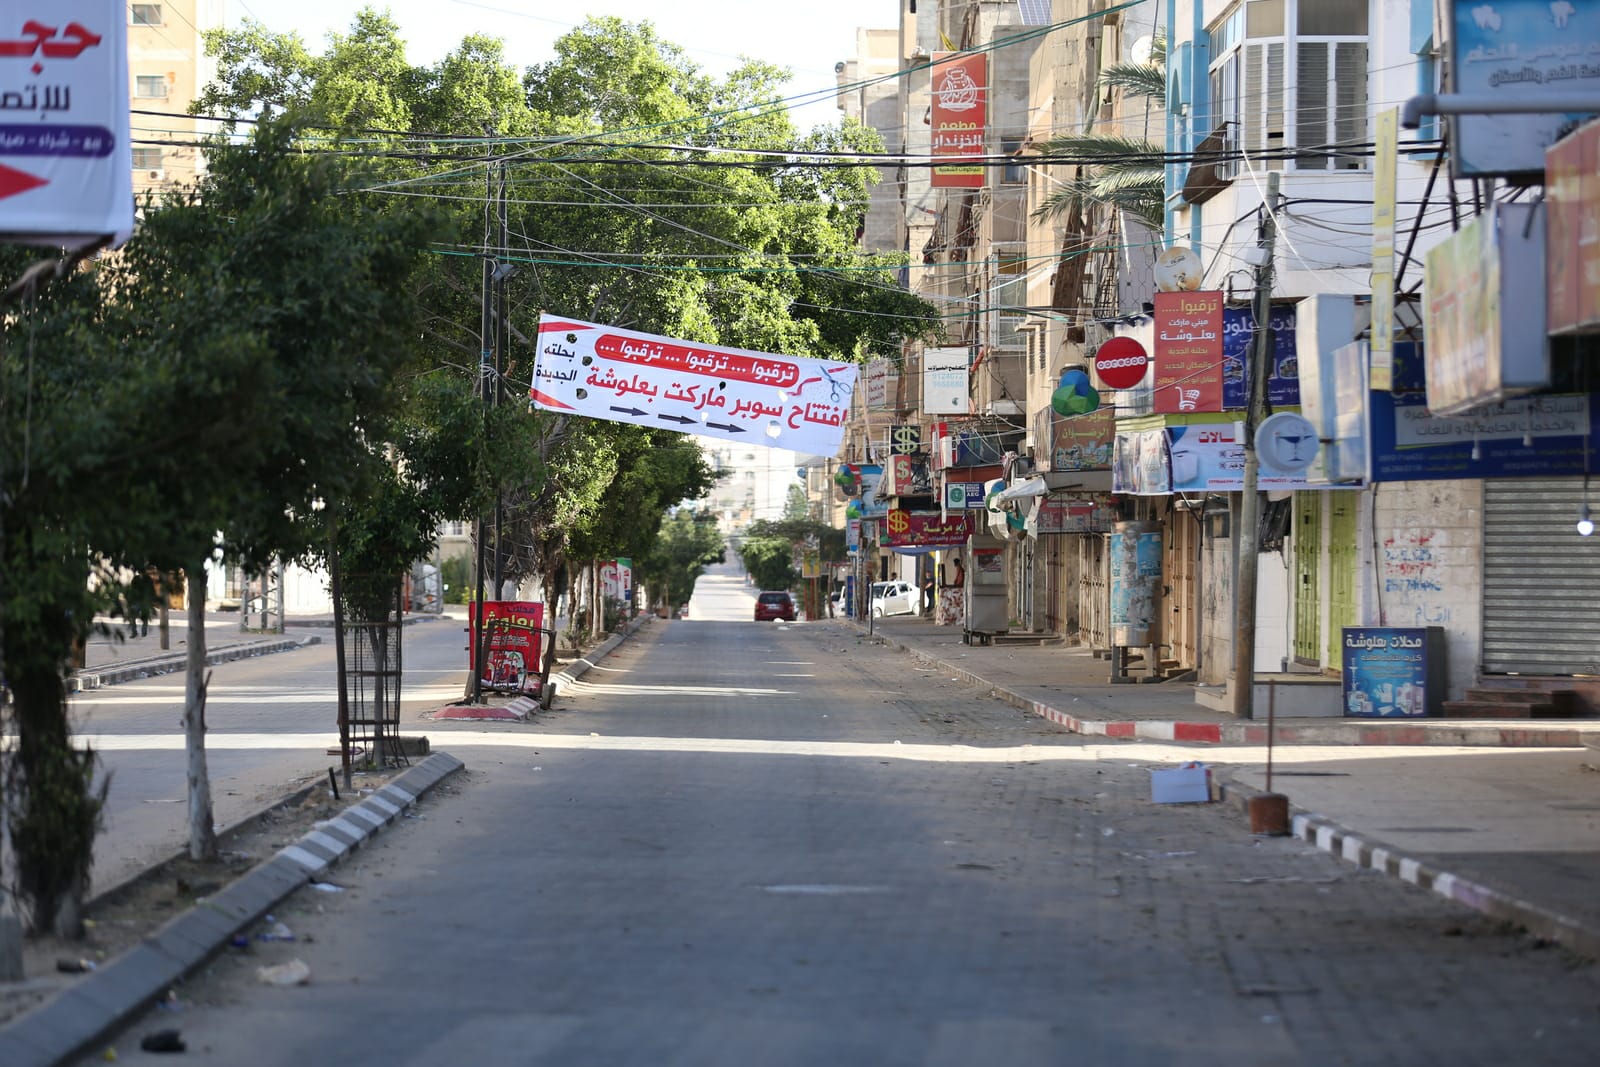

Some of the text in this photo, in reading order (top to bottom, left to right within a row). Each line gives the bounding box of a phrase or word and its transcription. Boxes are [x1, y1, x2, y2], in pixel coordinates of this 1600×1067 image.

[0, 19, 102, 75] حج
[0, 84, 70, 120] للإتص
[938, 121, 977, 133] مطعم
[933, 134, 982, 149] الخزندار
[620, 341, 663, 361] ترقبوا
[685, 351, 728, 374] ترقبوا
[1096, 355, 1146, 370] ooredoo
[536, 363, 577, 383] الجديدة
[751, 361, 796, 387] ترقبوا
[586, 367, 848, 429] افتتاح سوبر ماركت بعلوشة
[1346, 633, 1422, 651] محلات بعلوشة
